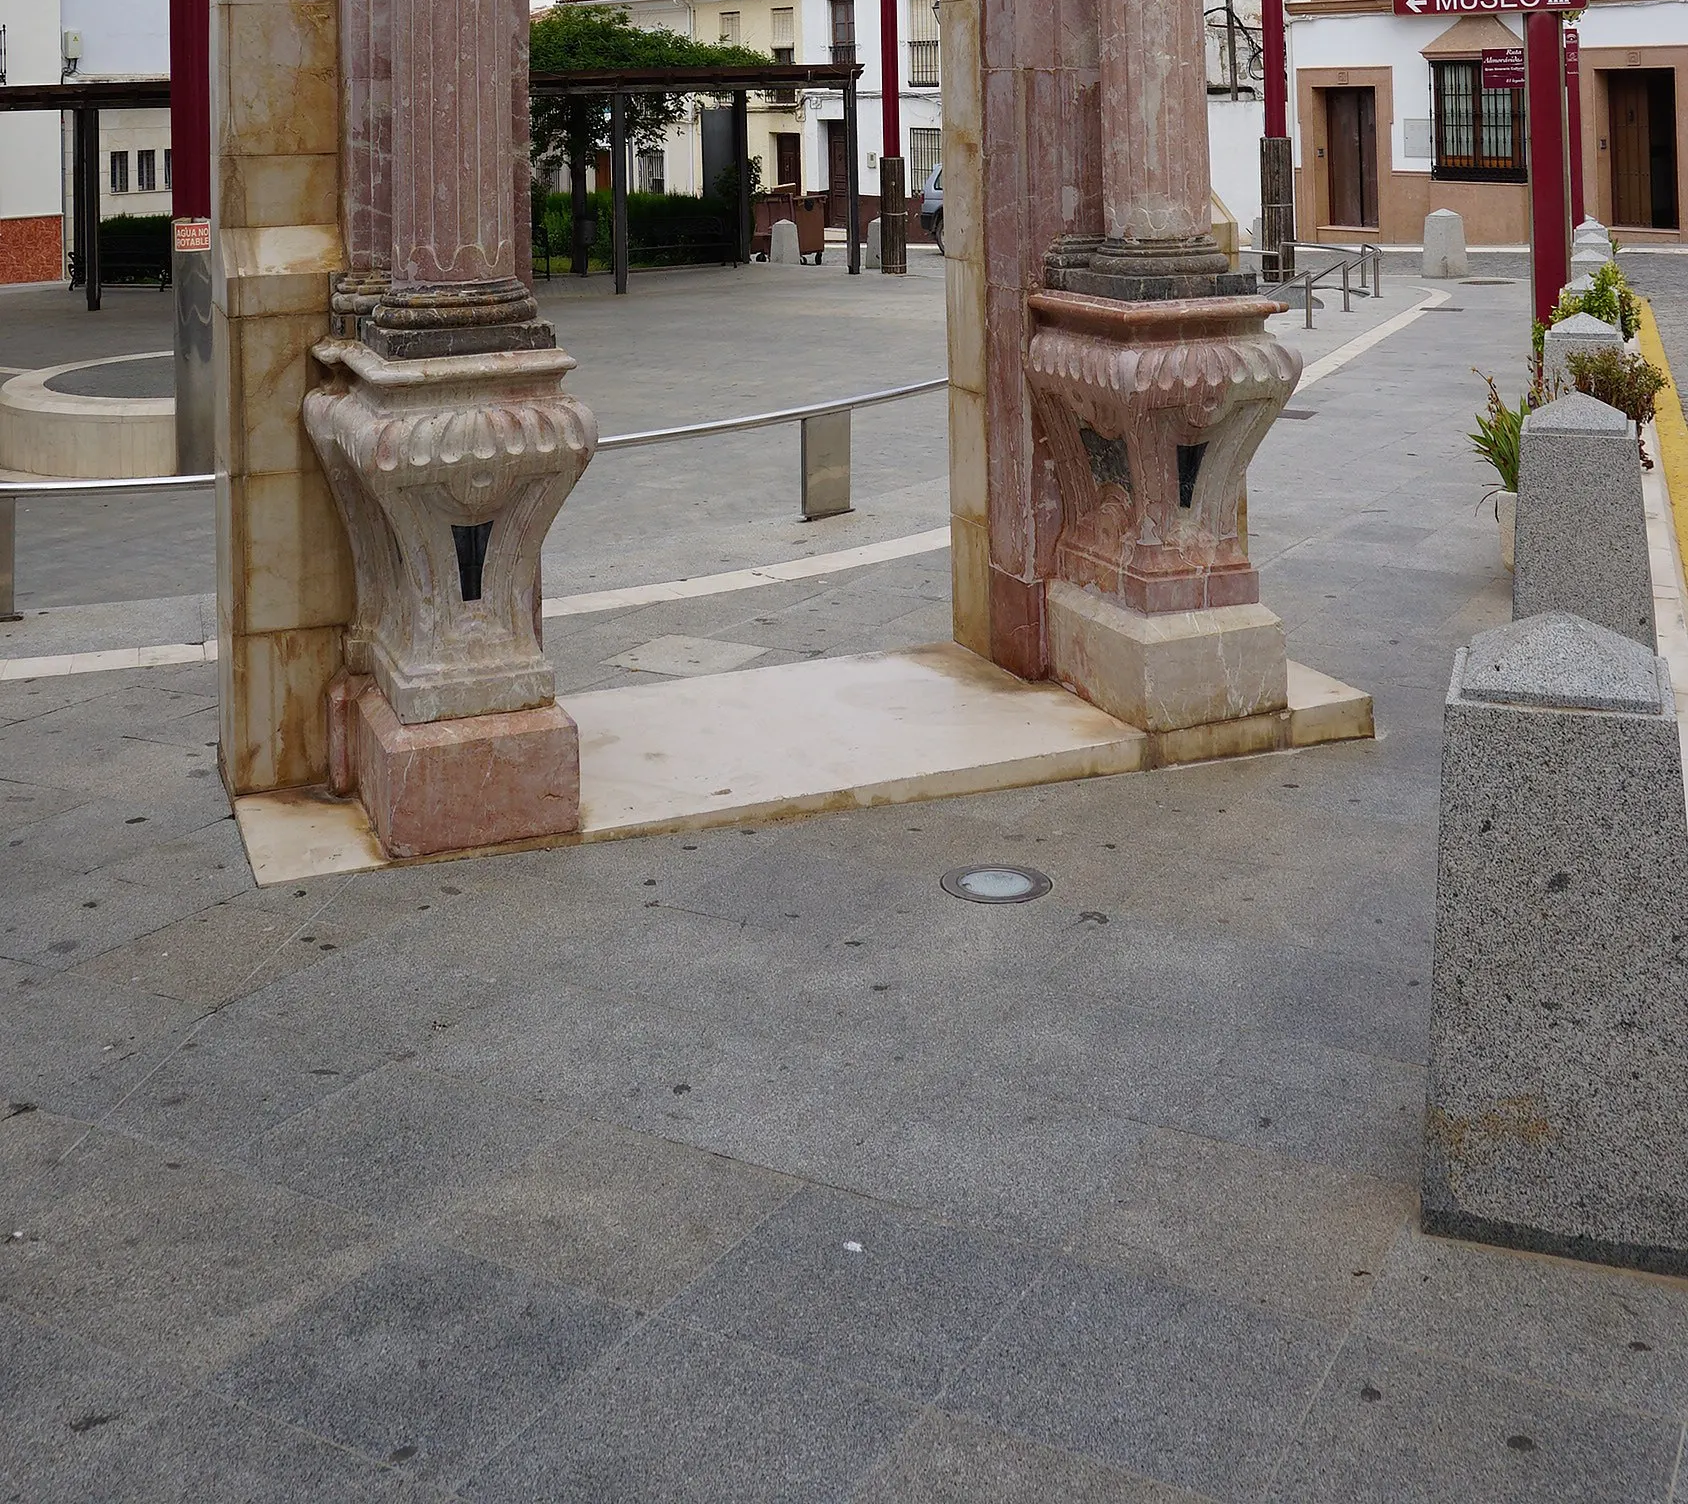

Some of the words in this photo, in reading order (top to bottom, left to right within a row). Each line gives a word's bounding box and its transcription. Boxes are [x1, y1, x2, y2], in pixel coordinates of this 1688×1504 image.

[176, 228, 197, 237] AGUA
[198, 227, 209, 236] NO
[176, 237, 209, 247] POTABLE
